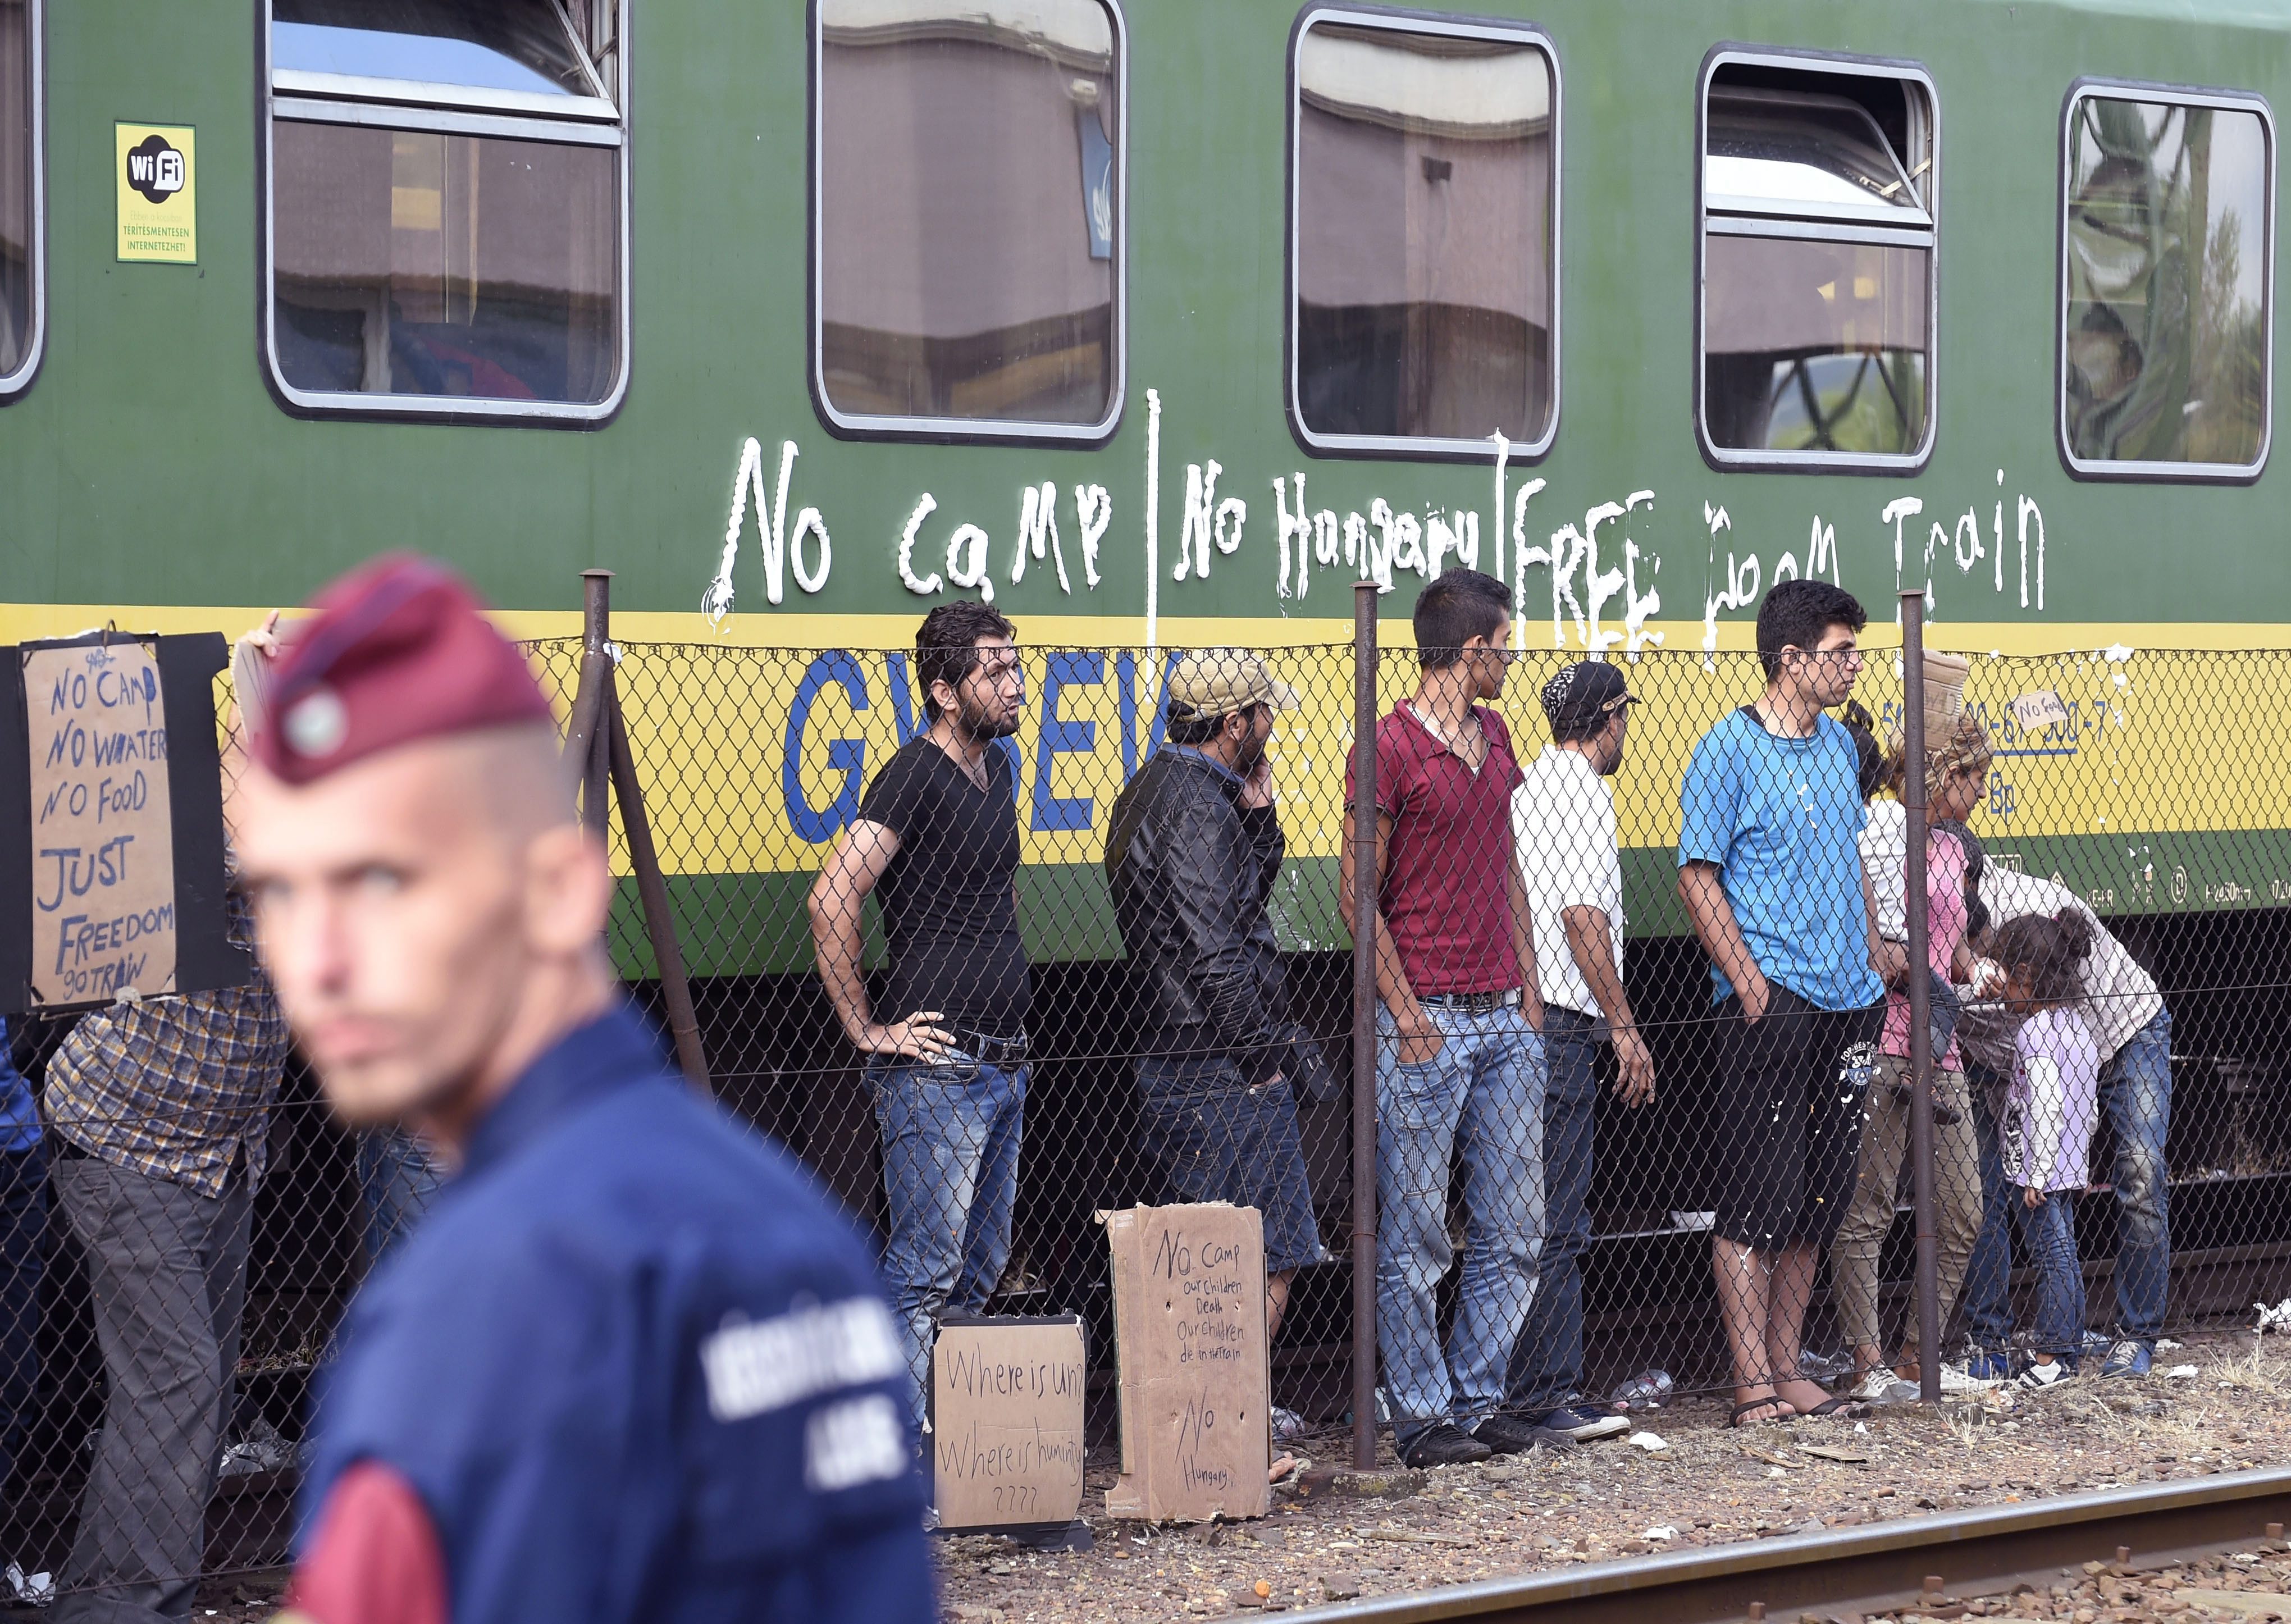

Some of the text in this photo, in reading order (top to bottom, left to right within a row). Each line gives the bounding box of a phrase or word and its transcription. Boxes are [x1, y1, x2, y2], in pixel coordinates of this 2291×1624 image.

[123, 223, 189, 237] TÉRÍTÉSMENTESEN
[127, 240, 185, 252] INTERNETEZHET!
[702, 436, 832, 621] No
[1174, 459, 1247, 582] No
[51, 668, 86, 715] NO
[46, 719, 86, 768] NO
[40, 781, 86, 824] NO
[36, 835, 135, 912] JUST
[55, 902, 175, 975] FREEDOM
[1196, 1297, 1223, 1315] Death
[947, 1342, 1024, 1398] Where
[1030, 1359, 1046, 1399] is
[939, 1420, 1012, 1479] Where
[1019, 1441, 1032, 1474] is
[1175, 1386, 1214, 1464] No
[993, 1485, 1037, 1515] ????
